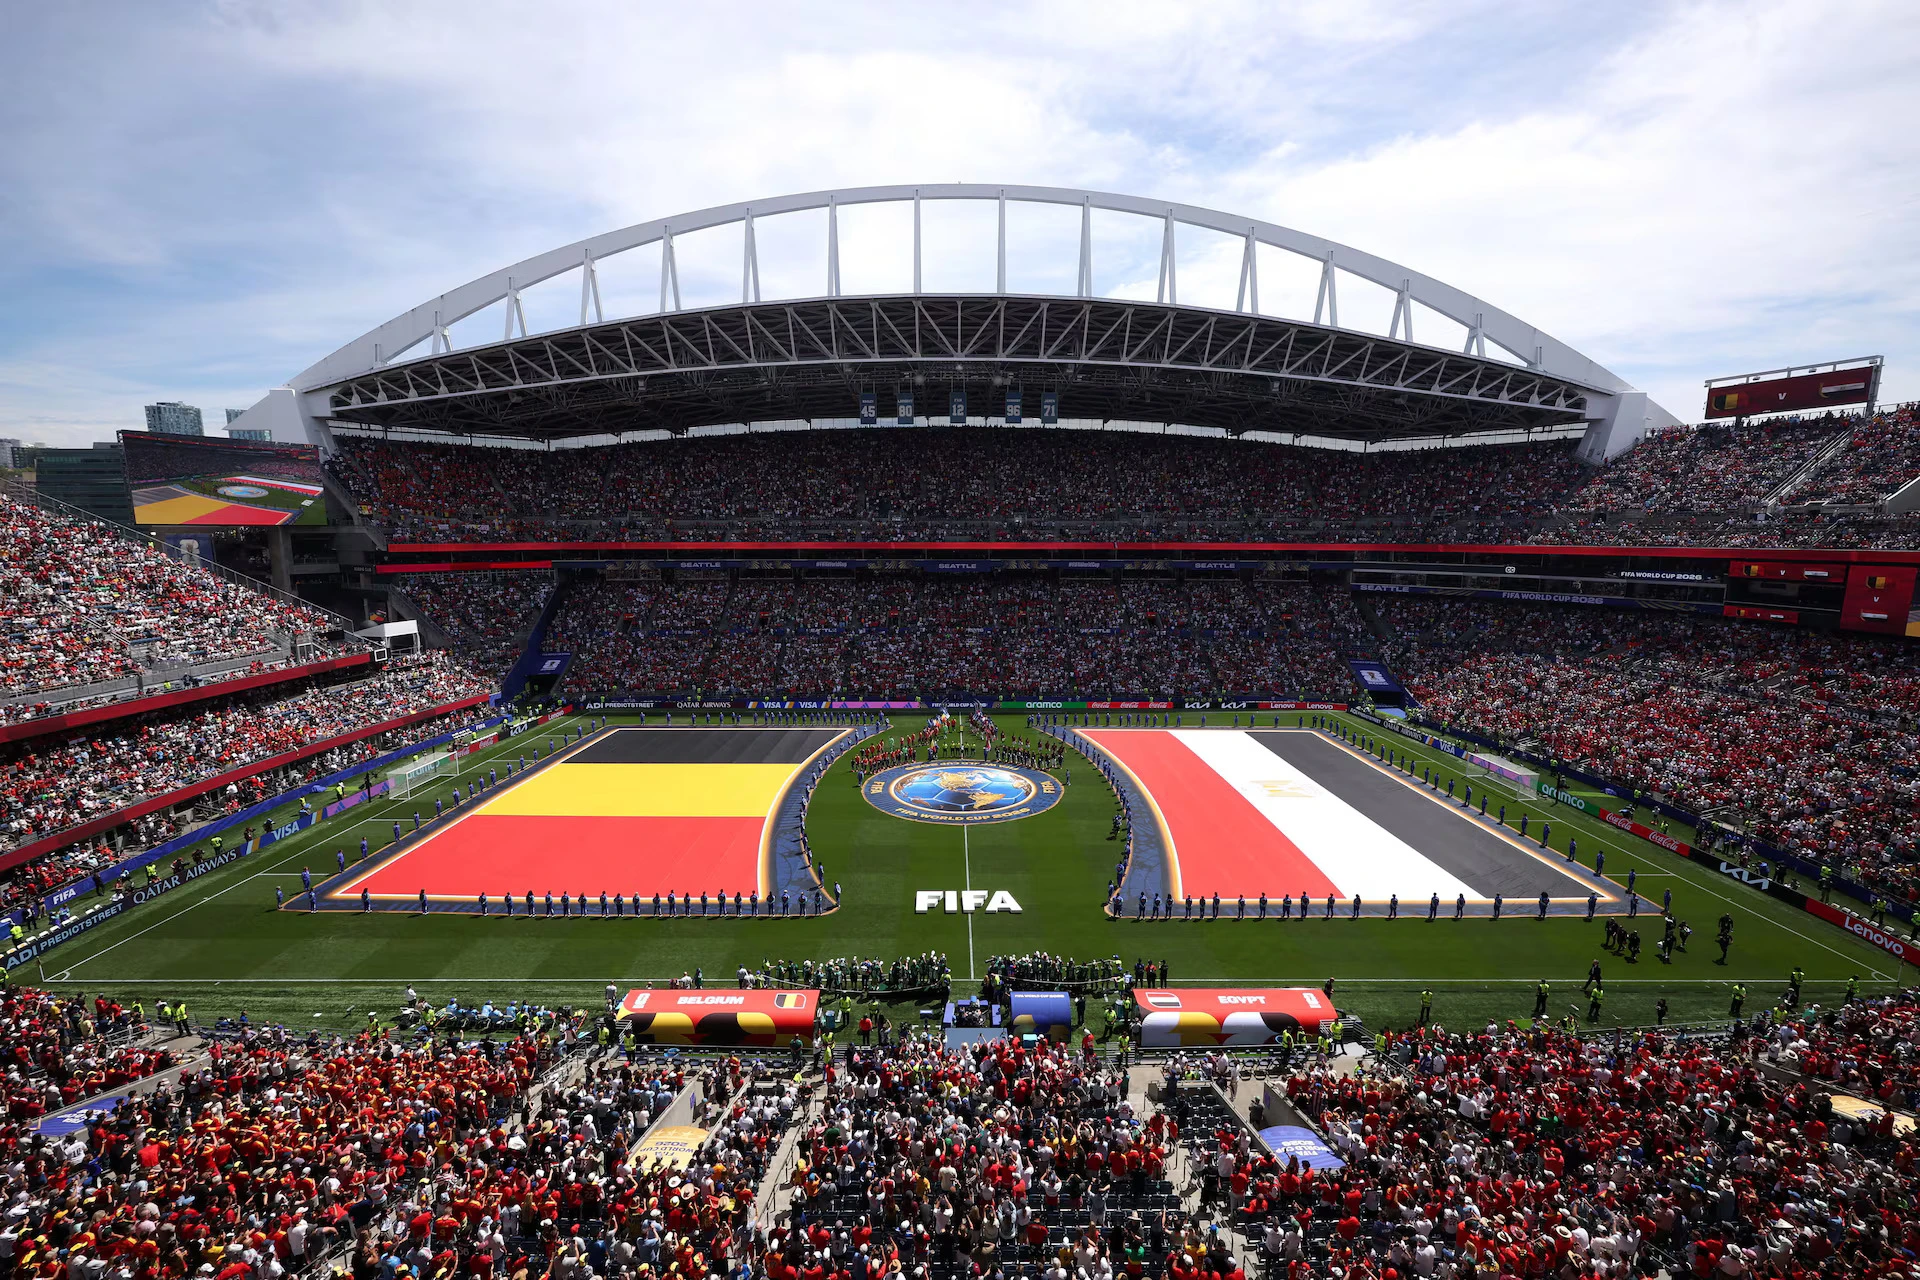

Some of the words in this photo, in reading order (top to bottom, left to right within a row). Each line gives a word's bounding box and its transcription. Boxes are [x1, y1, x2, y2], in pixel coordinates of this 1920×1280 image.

[861, 405, 876, 418] 45
[899, 405, 913, 417] 80
[952, 404, 965, 416] 12
[1007, 405, 1020, 417] 96
[1044, 405, 1055, 417] 71
[1360, 585, 1410, 593] SEATTLE
[1521, 593, 1552, 601] WORLD
[1553, 594, 1571, 602] CUP
[1572, 596, 1604, 604] 2026
[547, 710, 565, 721] Lenovo
[1383, 721, 1400, 732] QATAR
[1439, 741, 1456, 755] VISA
[870, 781, 886, 795] FIFA
[1040, 780, 1056, 794] FIFA
[1542, 784, 1585, 809] aramco
[895, 807, 918, 817] FIFA
[991, 807, 1031, 819] 2026
[272, 821, 300, 841] VISA
[133, 875, 181, 905] QATAR
[185, 849, 237, 882] AIRWAYS
[53, 889, 76, 905] FIFA
[915, 890, 1024, 914] FIFA
[6, 945, 38, 970] ADI
[40, 903, 123, 951] PREDICTSTREET
[1844, 916, 1904, 955] Lenovo
[677, 996, 744, 1005] BELGIUM
[1218, 995, 1266, 1004] EGYPT
